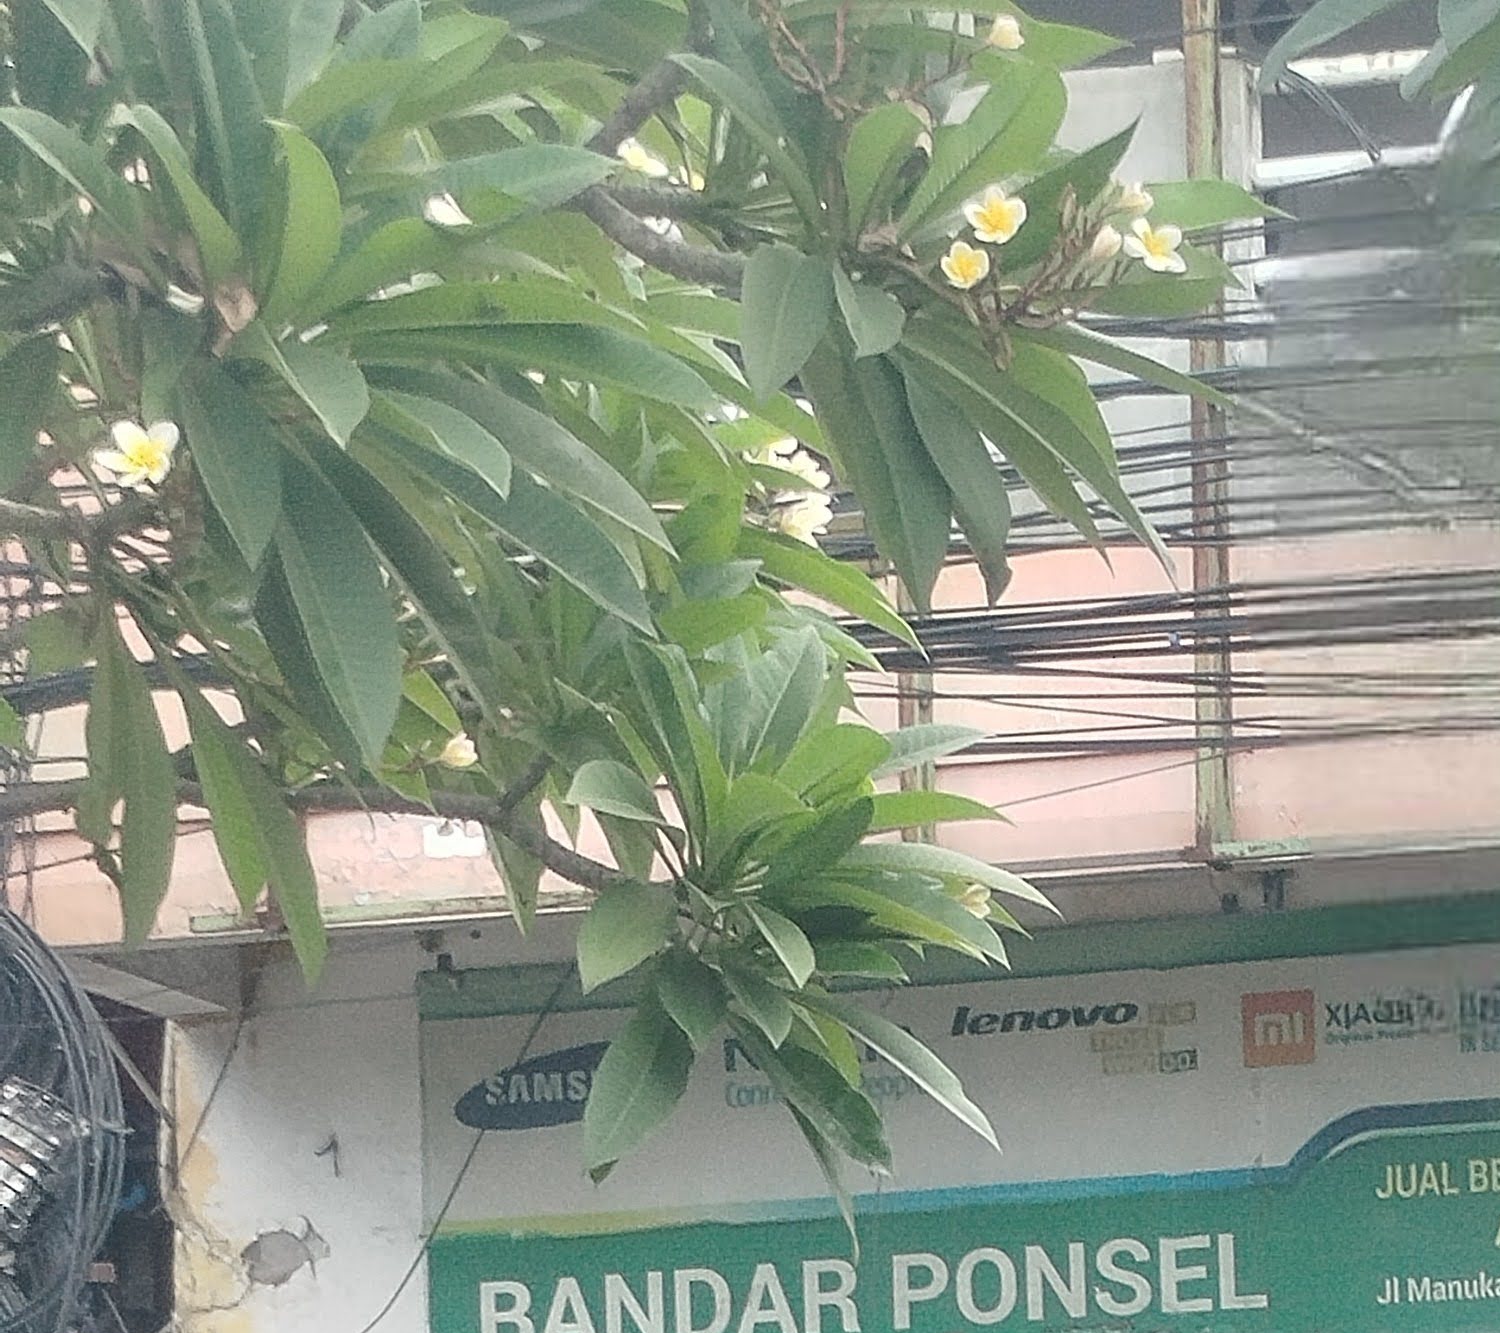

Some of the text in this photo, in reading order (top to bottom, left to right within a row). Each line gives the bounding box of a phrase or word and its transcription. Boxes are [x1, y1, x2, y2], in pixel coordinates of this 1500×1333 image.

[951, 1001, 1138, 1036] lenovo
[485, 1070, 592, 1104] SAMS
[1375, 1161, 1460, 1200] JUAL
[892, 1232, 1269, 1331] PONSEL
